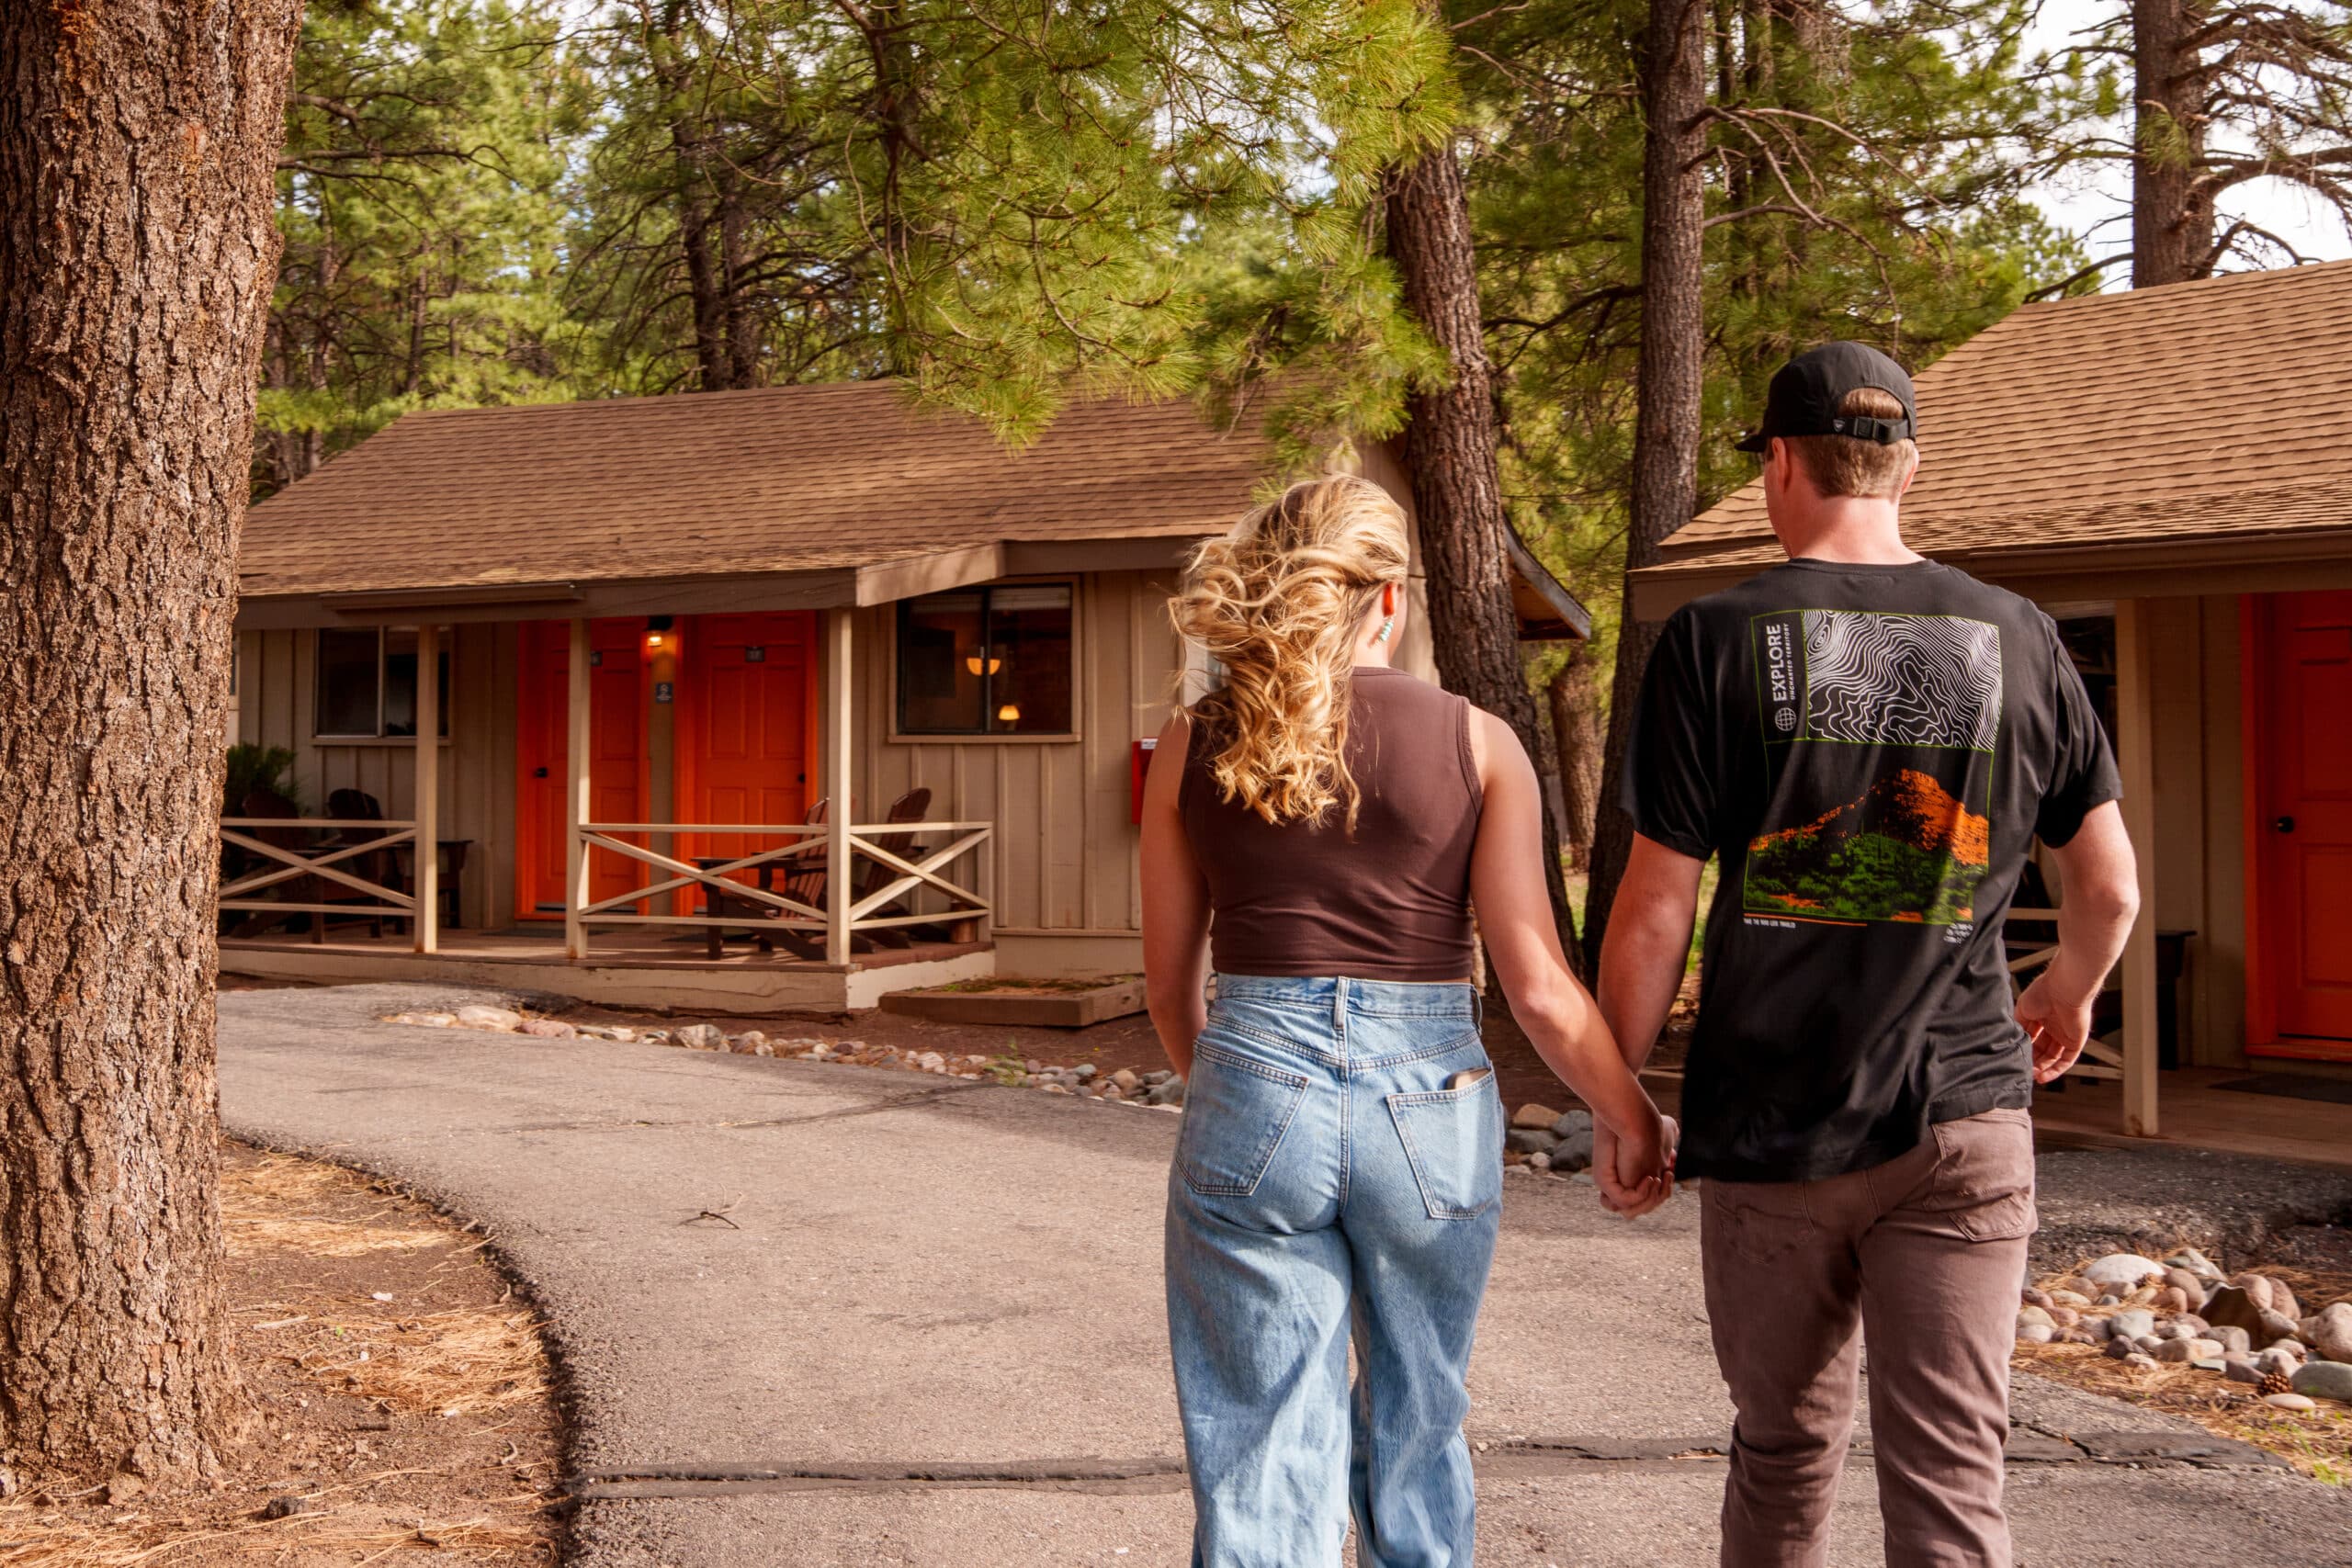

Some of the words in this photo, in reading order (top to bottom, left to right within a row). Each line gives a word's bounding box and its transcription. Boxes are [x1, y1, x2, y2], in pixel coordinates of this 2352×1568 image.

[1783, 622, 1792, 659] TERRITORY
[1766, 624, 1788, 702] EXPLORE
[1787, 660, 1795, 701] UNCHARTED
